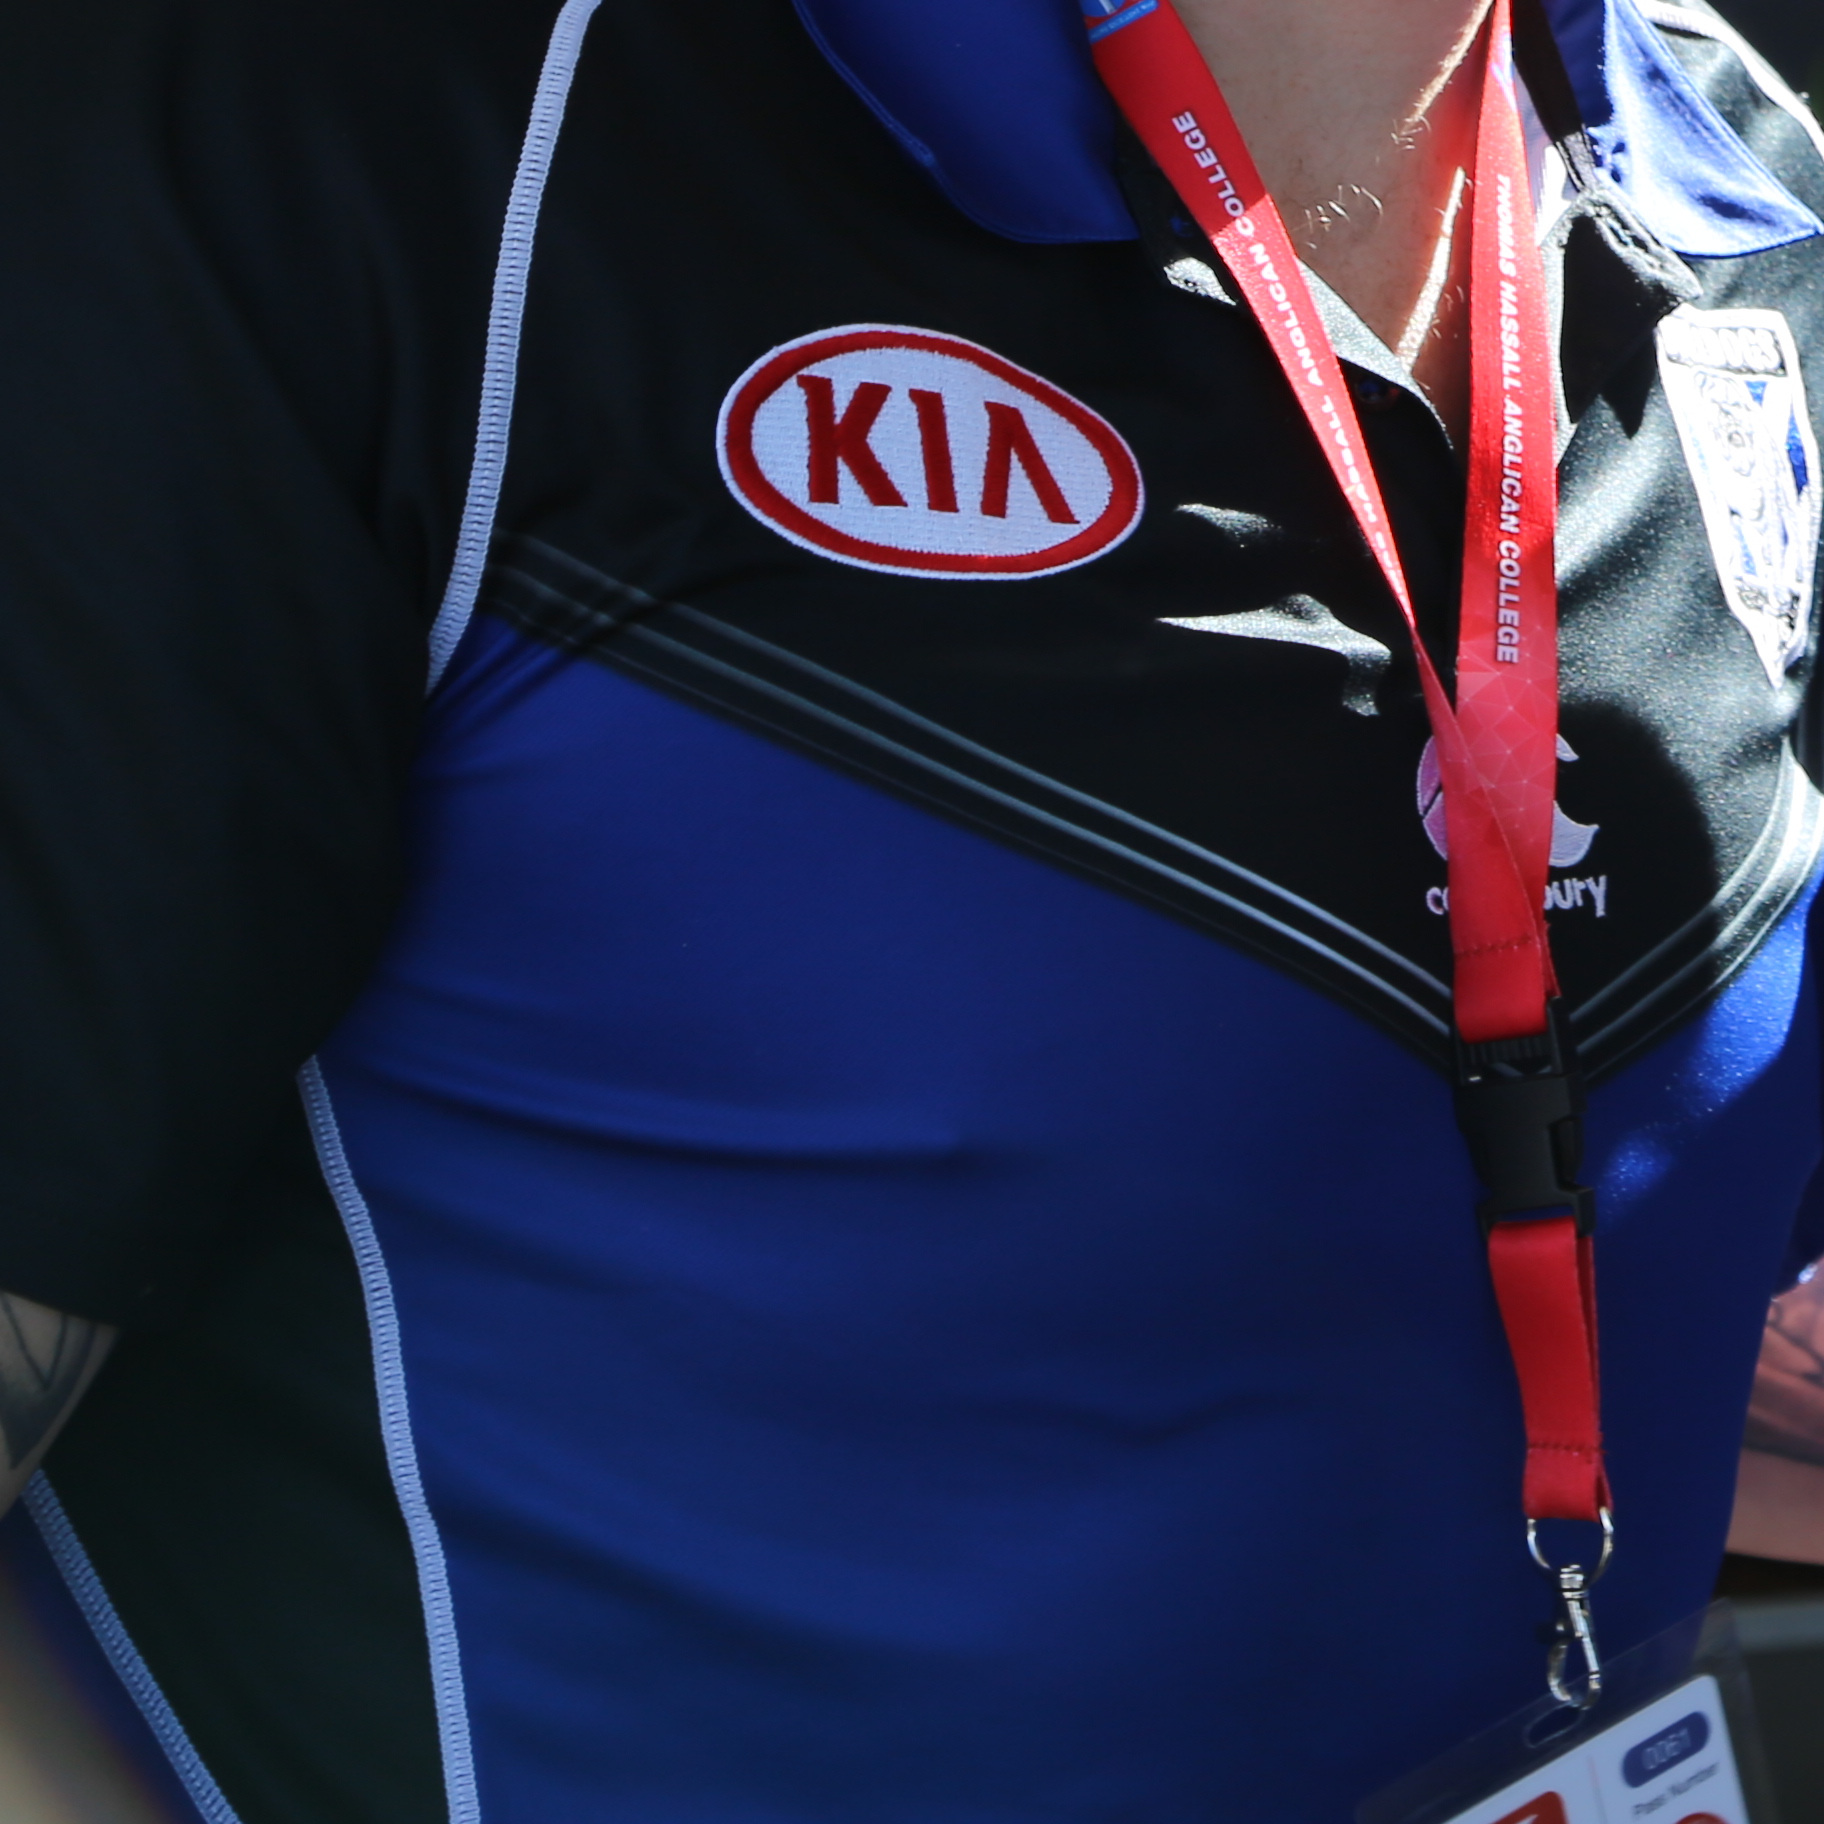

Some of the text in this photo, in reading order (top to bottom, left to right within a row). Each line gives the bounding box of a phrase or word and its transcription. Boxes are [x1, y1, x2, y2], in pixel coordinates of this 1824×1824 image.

[1172, 110, 1255, 236] COLLEGE
[1248, 242, 1324, 387] ANGLICAN
[795, 373, 1082, 525] KIA
[1496, 173, 1524, 663] THOMAS HASSALL ANGLICAN COLLEGE
